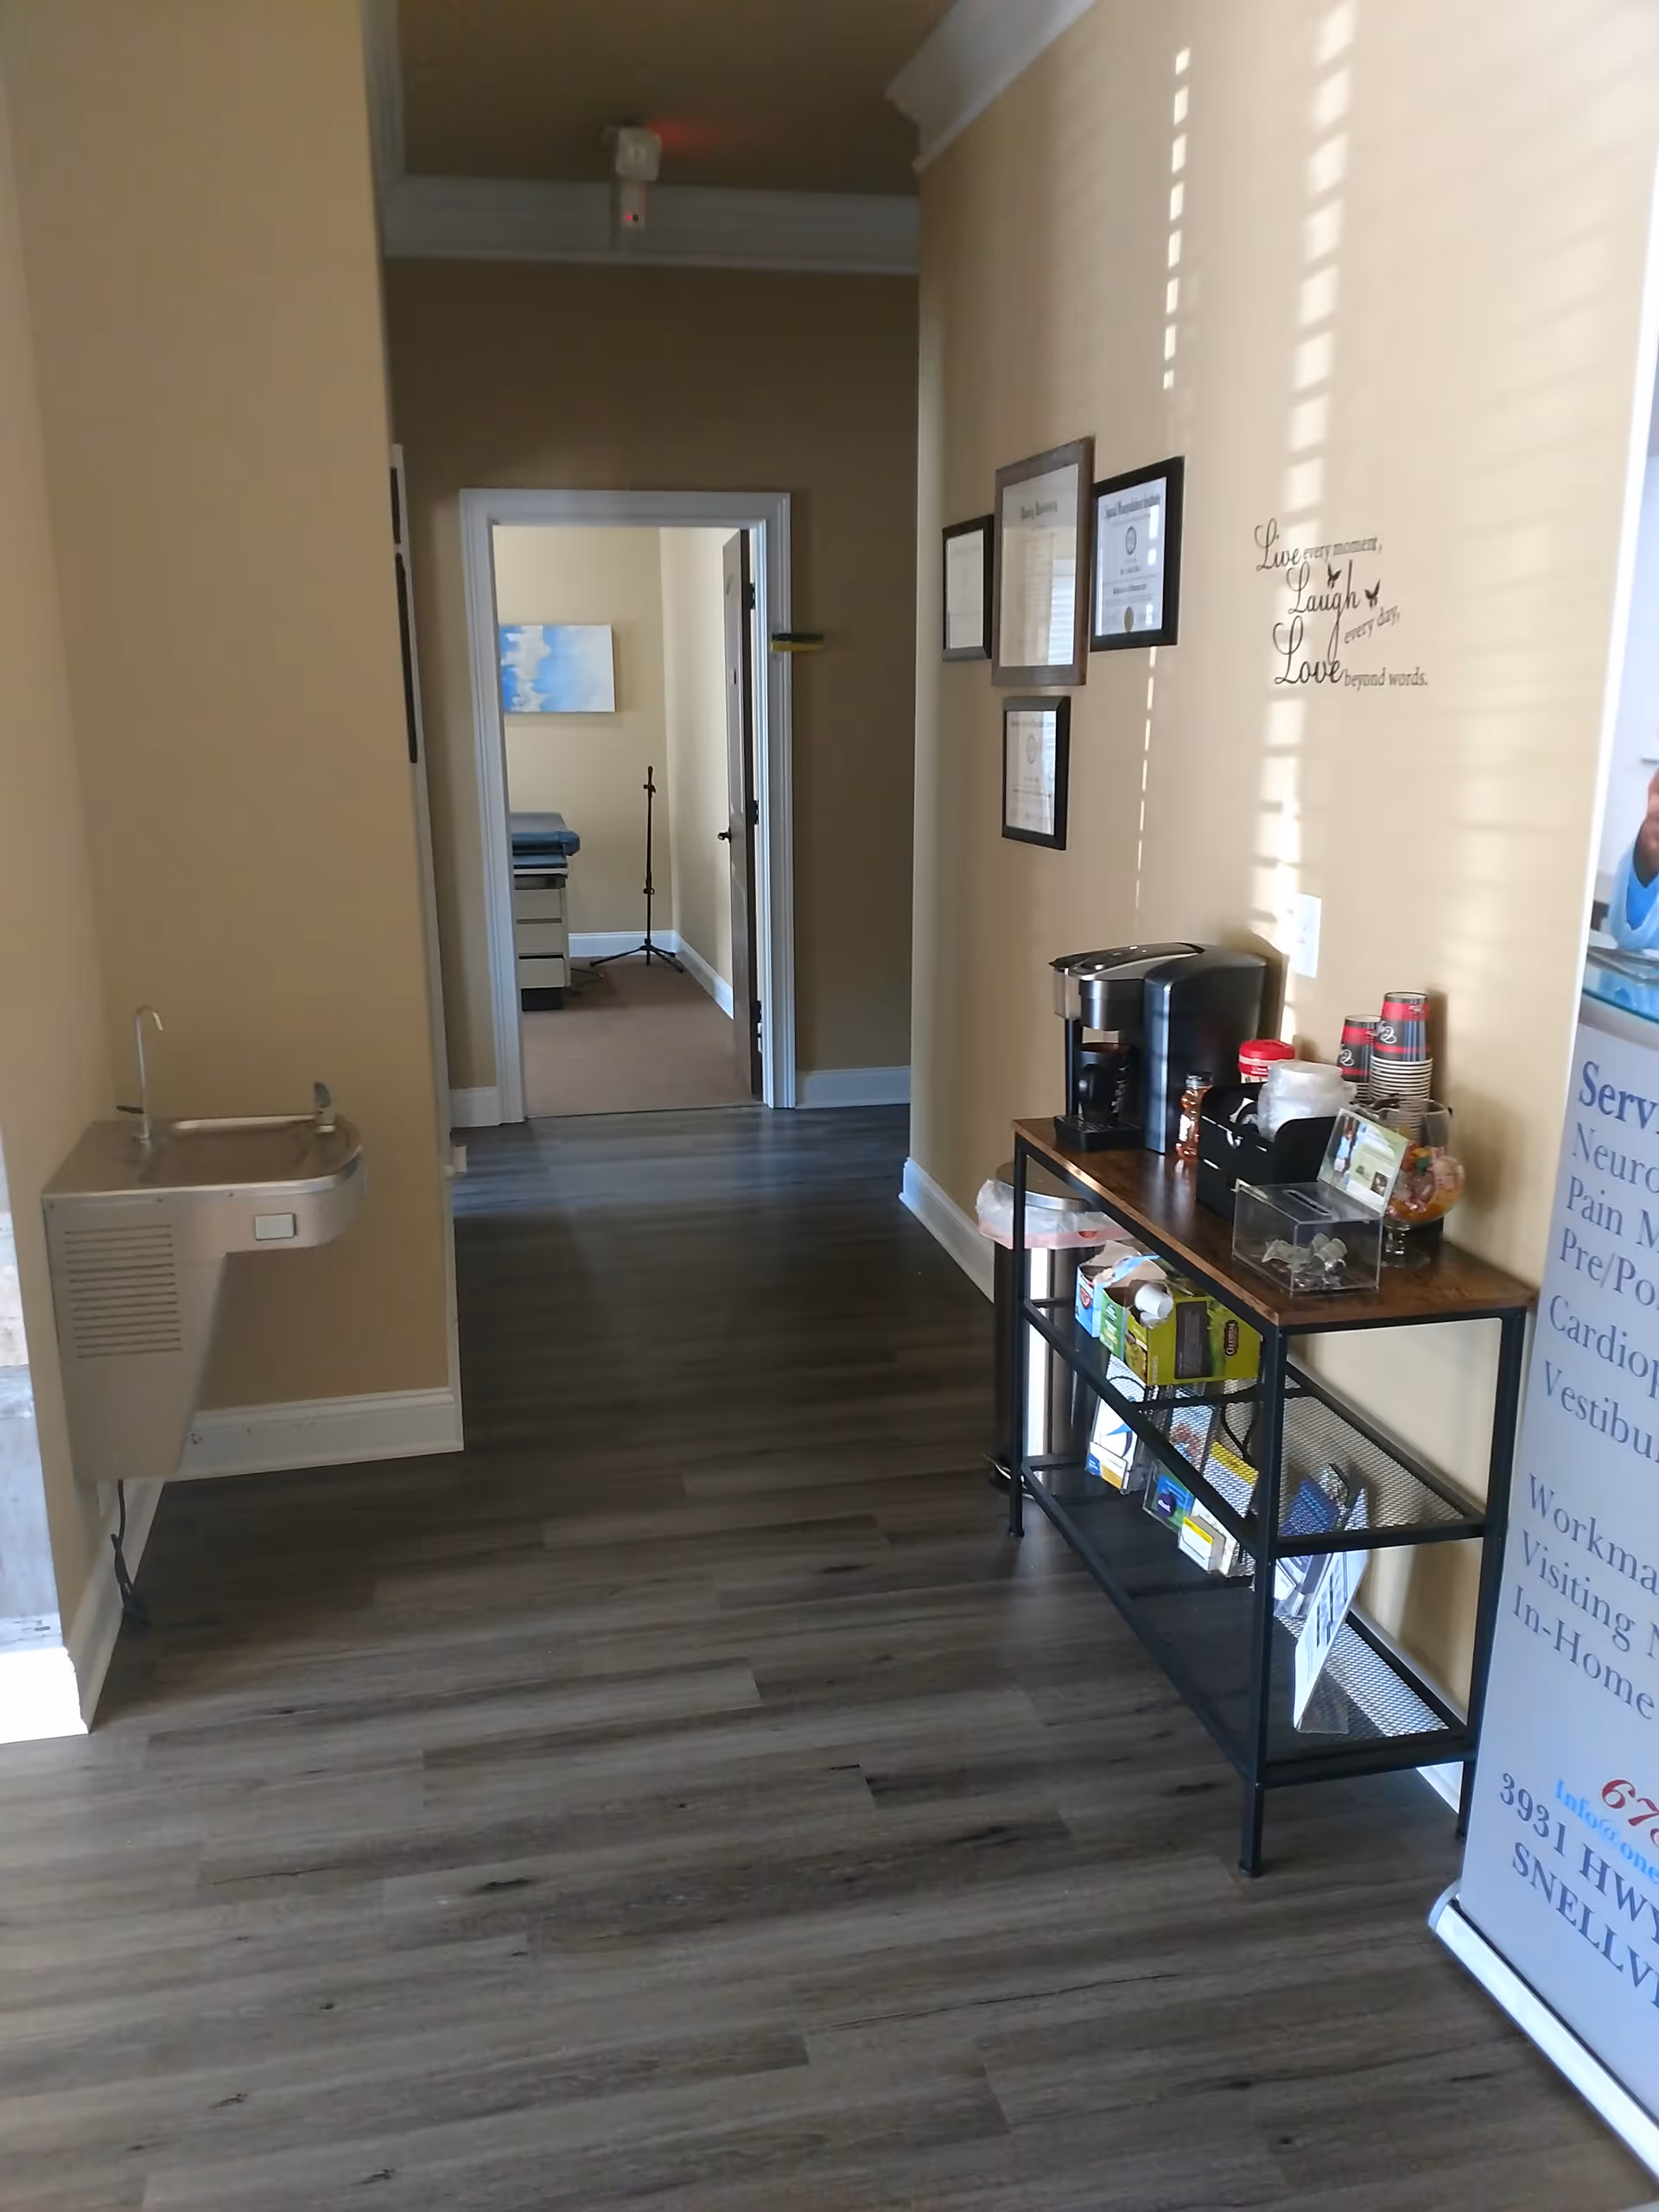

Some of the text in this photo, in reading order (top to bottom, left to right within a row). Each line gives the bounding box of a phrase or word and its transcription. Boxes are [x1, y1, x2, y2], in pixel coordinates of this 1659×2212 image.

[1255, 518, 1301, 571] Live
[1273, 614, 1344, 685] Love
[1344, 667, 1386, 691] beyond
[1287, 559, 1361, 665] Laugh
[1578, 1060, 1659, 1135] Serv
[1566, 1174, 1623, 1237] Pain
[1559, 1227, 1659, 1311] Pre/Po
[1545, 1358, 1659, 1464] Vestibu
[1529, 1471, 1659, 1596] Workma
[1522, 1529, 1637, 1653] Visiting
[1513, 1584, 1655, 1720] In-Home
[1500, 1772, 1567, 1858] 3931
[1601, 1778, 1659, 1850] 67
